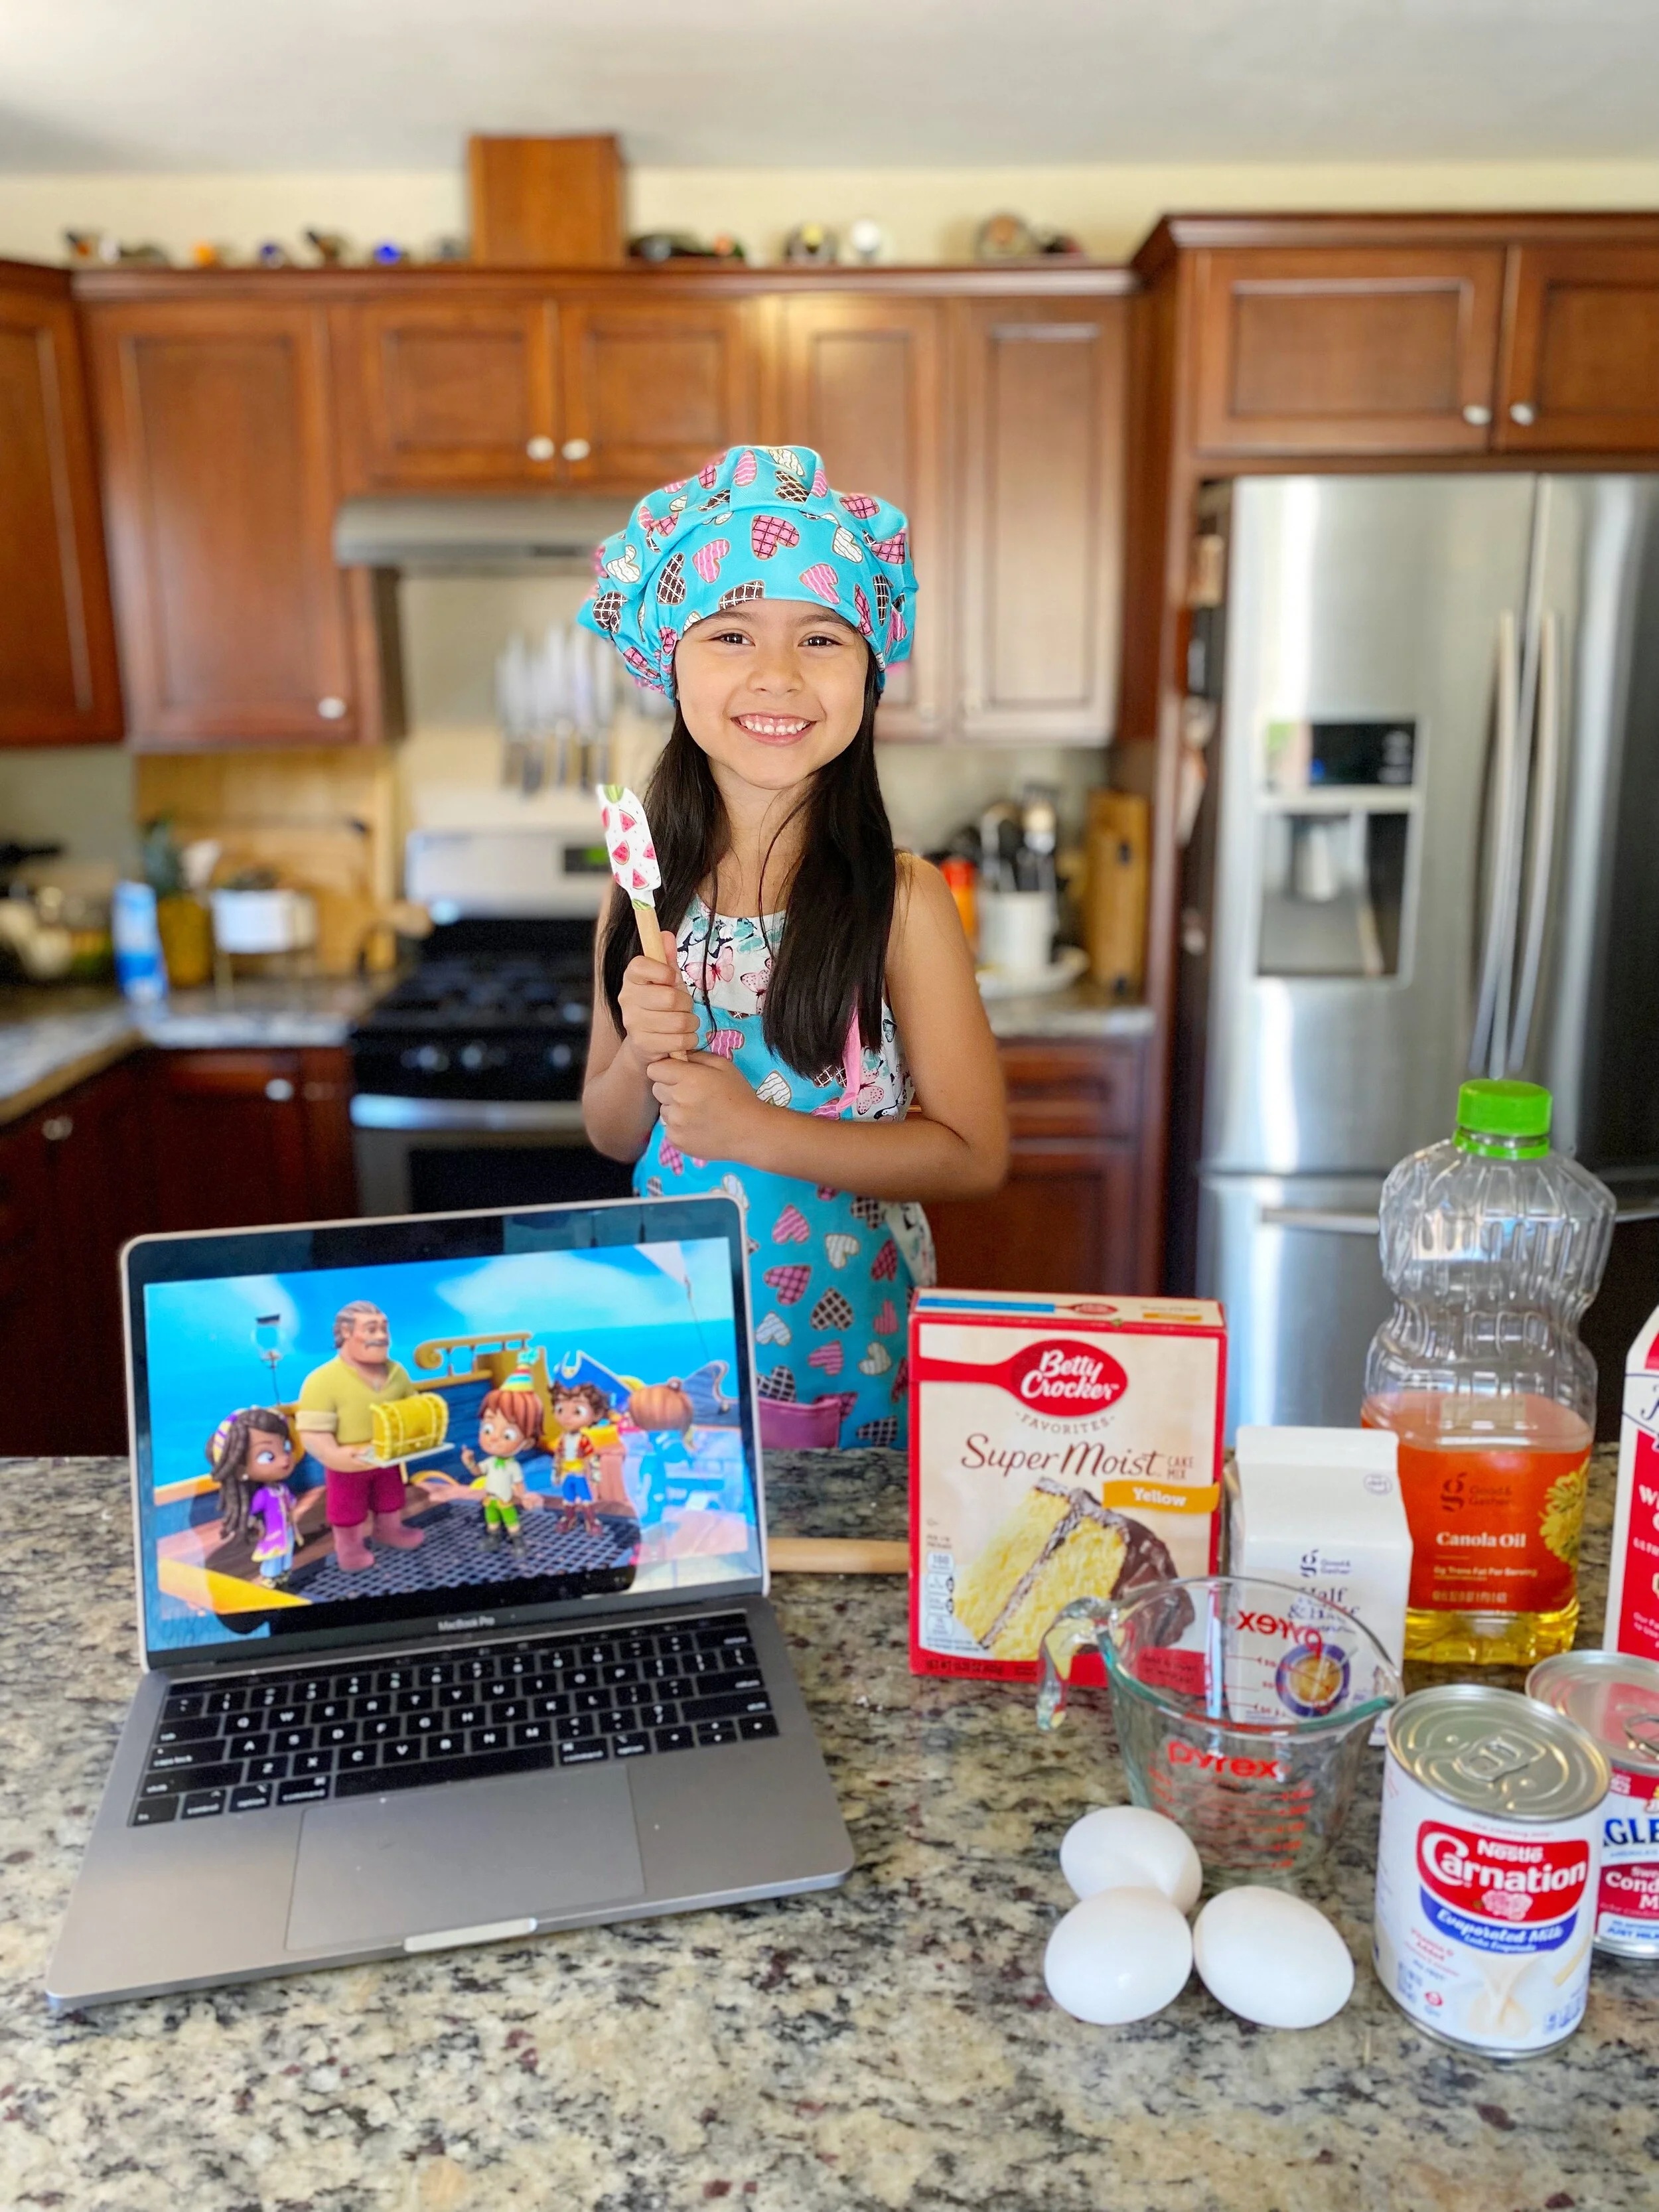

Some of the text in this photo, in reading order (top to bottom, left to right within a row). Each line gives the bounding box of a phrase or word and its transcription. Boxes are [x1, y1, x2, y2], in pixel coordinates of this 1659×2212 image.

[1040, 1349, 1103, 1383] Betty
[1167, 1457, 1194, 1469] CAKE
[1167, 1469, 1187, 1480] MIX
[1133, 1487, 1187, 1507] Yellow
[1436, 1531, 1526, 1548] Canola Oil
[438, 1615, 495, 1631] MacBook Pro
[1167, 1740, 1279, 1778] pyrex
[1421, 1831, 1587, 1893] Carnation
[1437, 1908, 1563, 1943] Evaporated Milk
